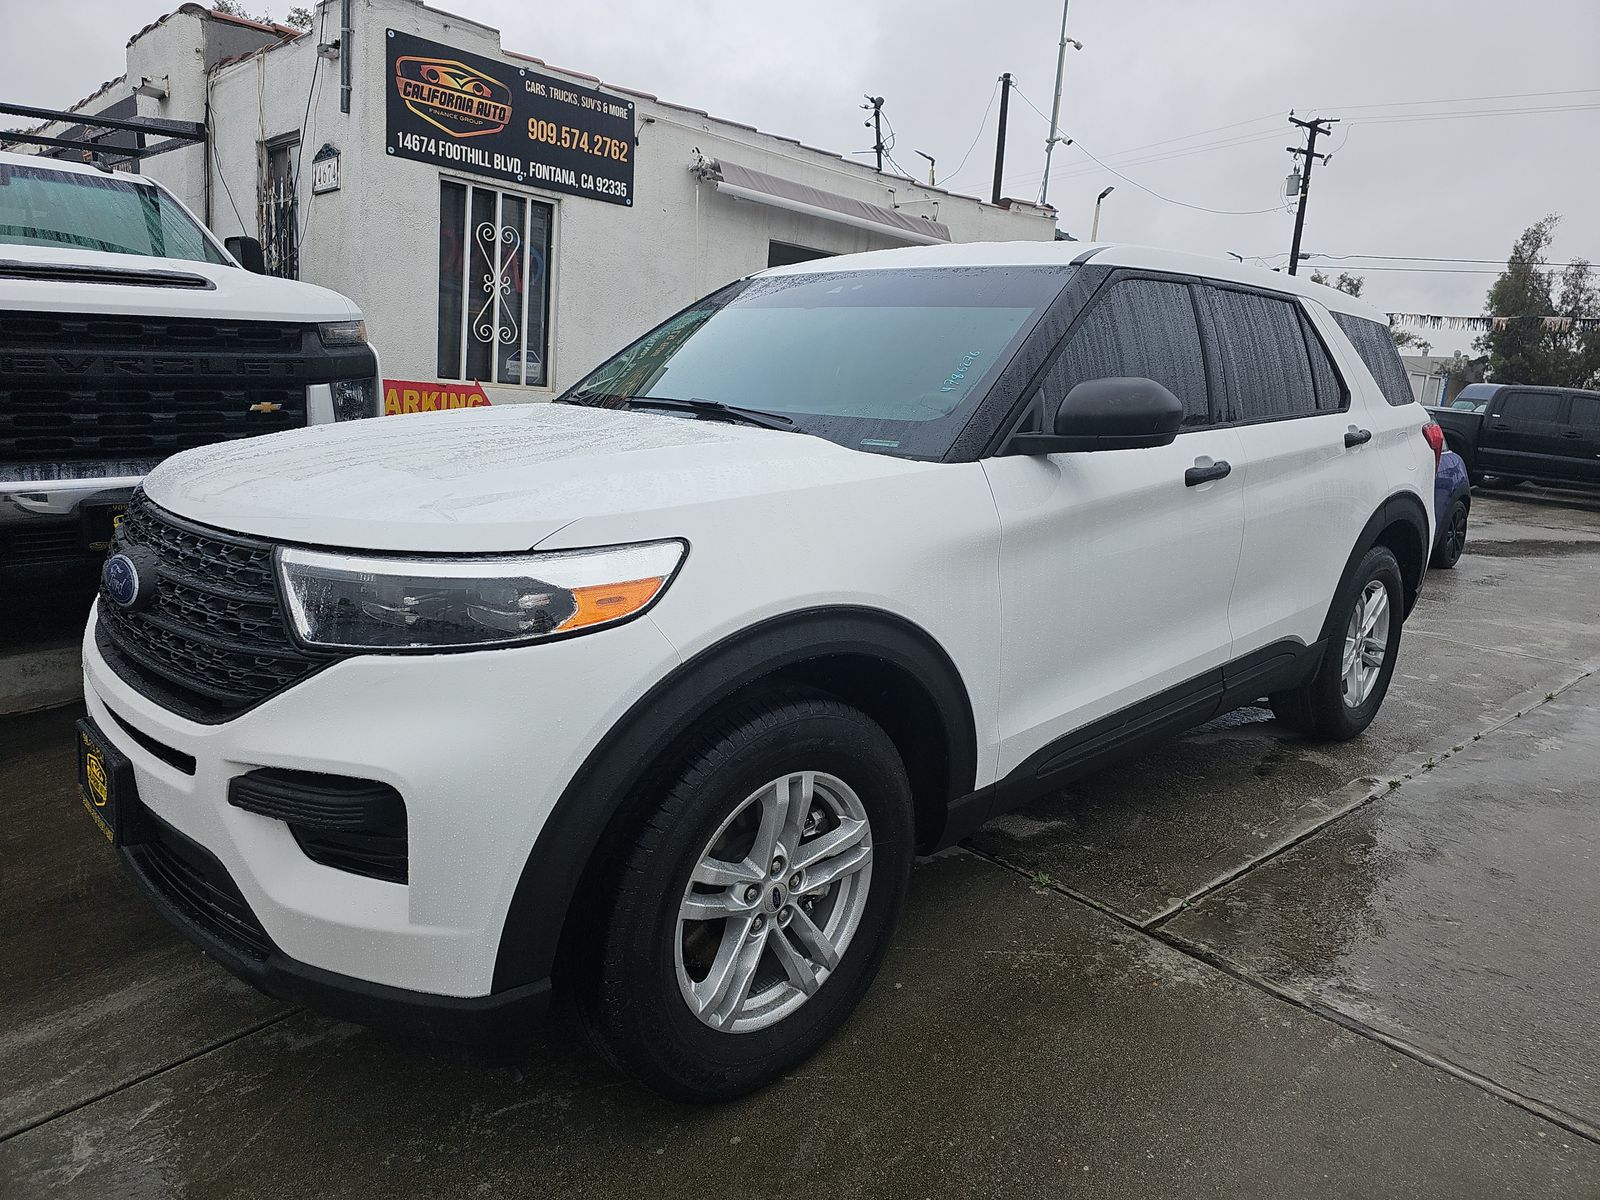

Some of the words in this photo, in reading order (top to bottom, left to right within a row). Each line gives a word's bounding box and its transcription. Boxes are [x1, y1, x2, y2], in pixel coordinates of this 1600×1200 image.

[403, 81, 474, 113] CALIFORNIA
[476, 101, 507, 121] AUTO
[429, 108, 459, 121] FINANCE
[459, 115, 484, 126] GROUP
[525, 80, 548, 98] CARS,
[549, 87, 580, 107] TRUCKS,
[581, 96, 602, 112] SUV'S
[602, 102, 608, 113] &
[609, 104, 628, 119] MORE
[528, 117, 628, 163] 909.574.2762
[397, 131, 436, 155] 14674
[438, 141, 492, 168] FOOTHILL
[494, 153, 527, 177] BLVD.,
[529, 162, 579, 189] FONTANA,
[581, 173, 594, 190] CA
[596, 177, 627, 197] 92335
